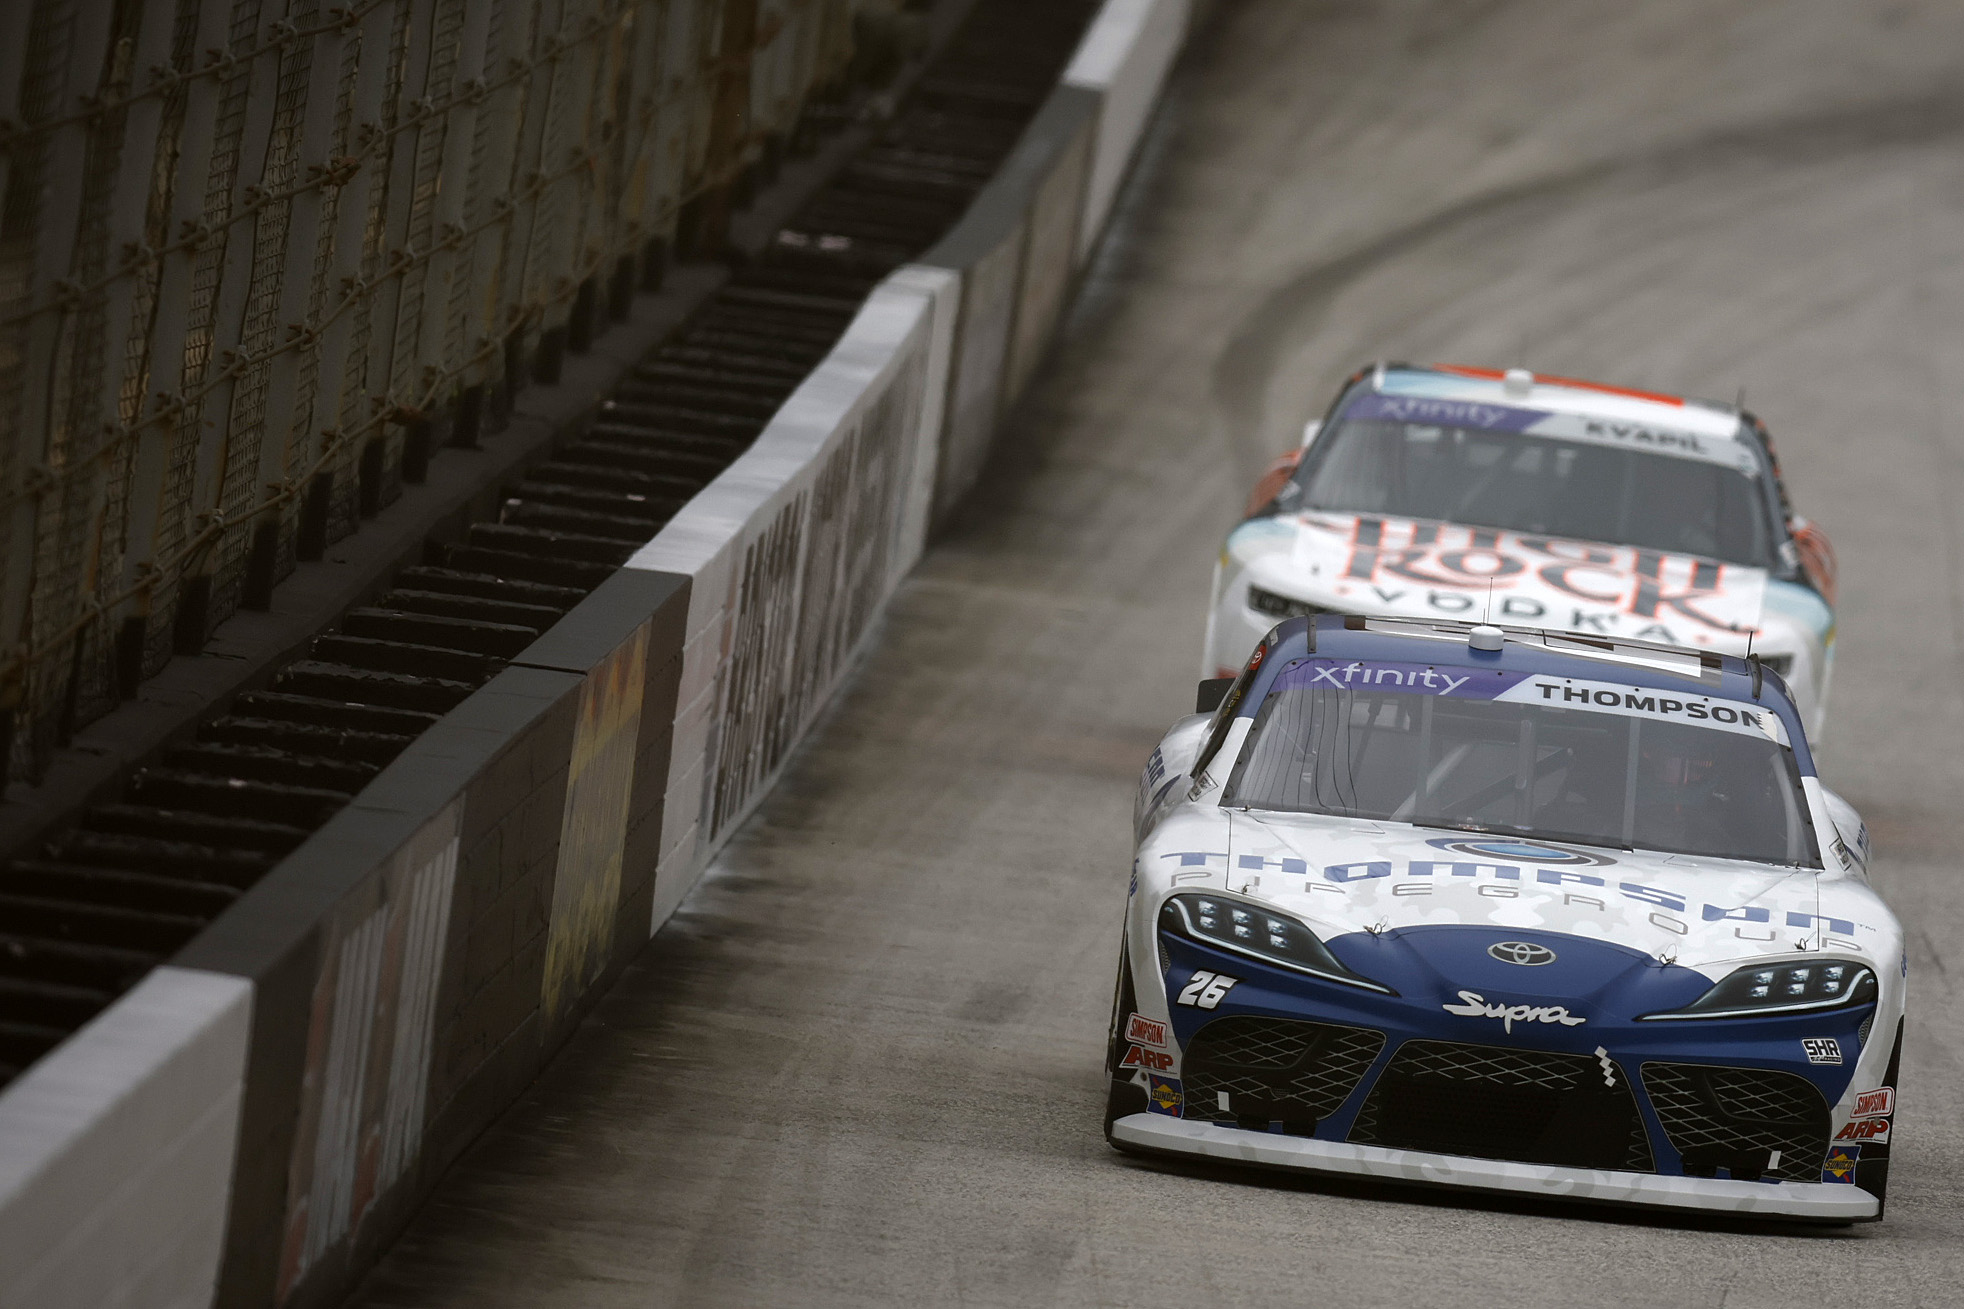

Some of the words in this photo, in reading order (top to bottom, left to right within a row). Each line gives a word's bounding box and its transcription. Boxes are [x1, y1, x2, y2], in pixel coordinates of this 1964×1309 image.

[1585, 421, 1709, 454] KVAPIL
[1343, 546, 1761, 637] ROCK
[1310, 662, 1471, 696] xfinity
[1160, 852, 1854, 936] THOMPSON
[1177, 970, 1238, 1009] 26
[1442, 990, 1587, 1035] Supra
[1131, 1018, 1163, 1044] SIMPSON
[1123, 1046, 1173, 1070] ARP
[1803, 1040, 1840, 1056] SHR
[1152, 1089, 1182, 1104] SUNOCO
[1854, 1092, 1888, 1115] SIMPSON
[1835, 1119, 1889, 1139] ARP
[1825, 1159, 1854, 1171] SUNOCO
